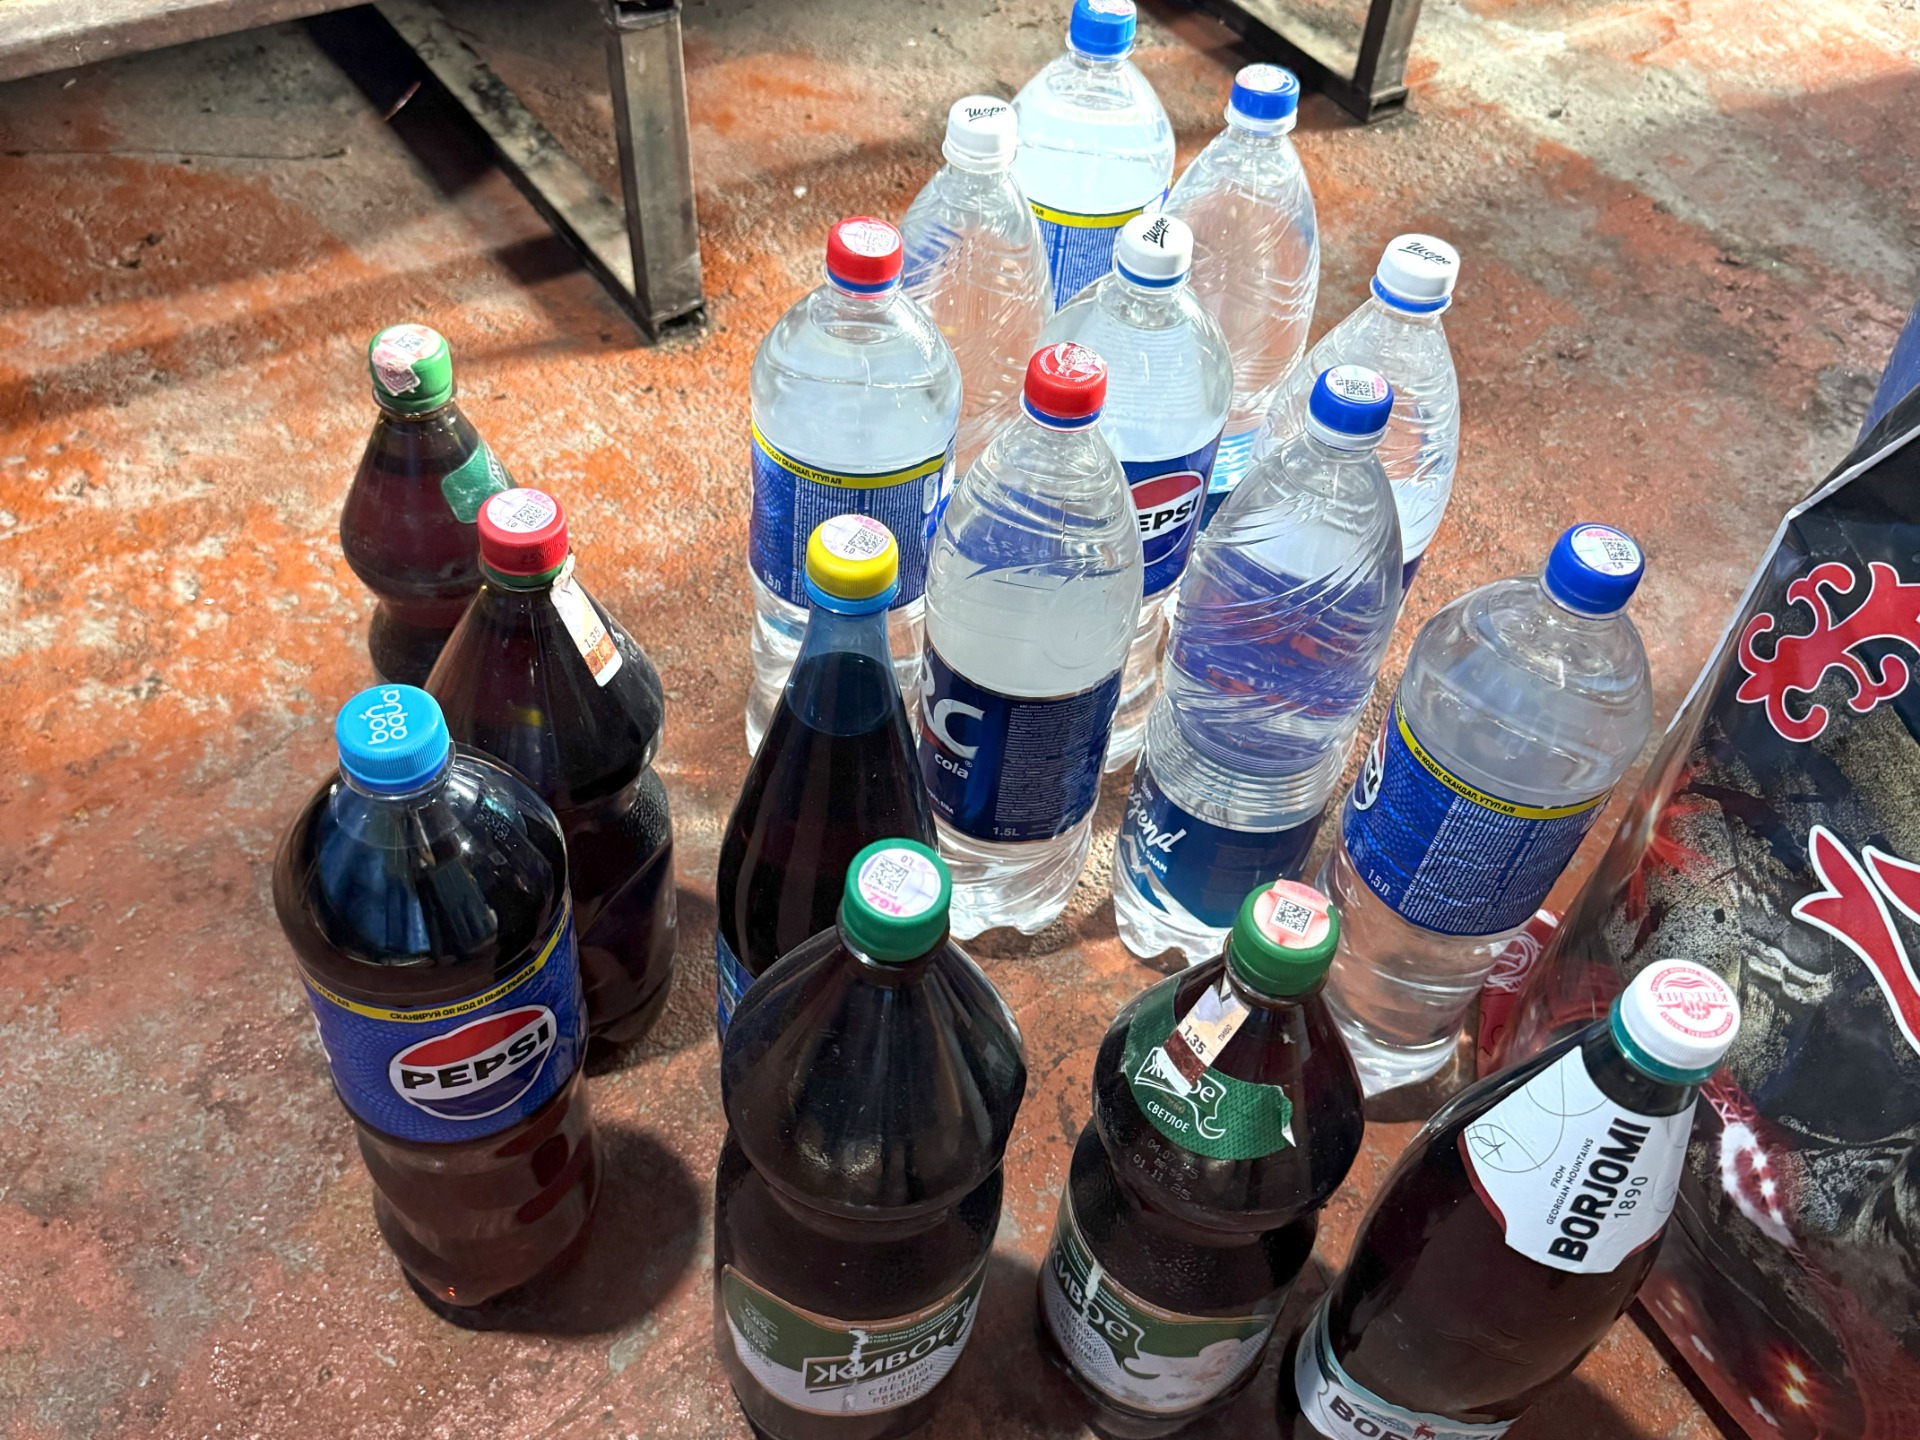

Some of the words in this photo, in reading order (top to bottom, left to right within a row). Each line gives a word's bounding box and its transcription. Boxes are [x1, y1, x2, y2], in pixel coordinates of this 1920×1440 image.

[1138, 493, 1200, 532] EPSI
[934, 753, 970, 780] cola
[1479, 796, 1502, 811] УТУП
[993, 826, 1021, 838] 1.5L
[1145, 850, 1168, 874] SHAN
[866, 892, 903, 915] KGZ
[390, 1009, 442, 1022] СКАНИРУЙ
[456, 1001, 477, 1014] КОД
[1182, 1024, 1207, 1056] 1,35
[401, 1021, 551, 1091] PEPSI
[1146, 1100, 1191, 1134] СВЕТЛОЕ
[1546, 1186, 1570, 1226] GEORGIAN
[1568, 1137, 1594, 1187] MOUNTAINS
[1548, 1117, 1651, 1263] BORJOMI
[1550, 1165, 1567, 1189] FROM
[1613, 1176, 1648, 1219] 1890
